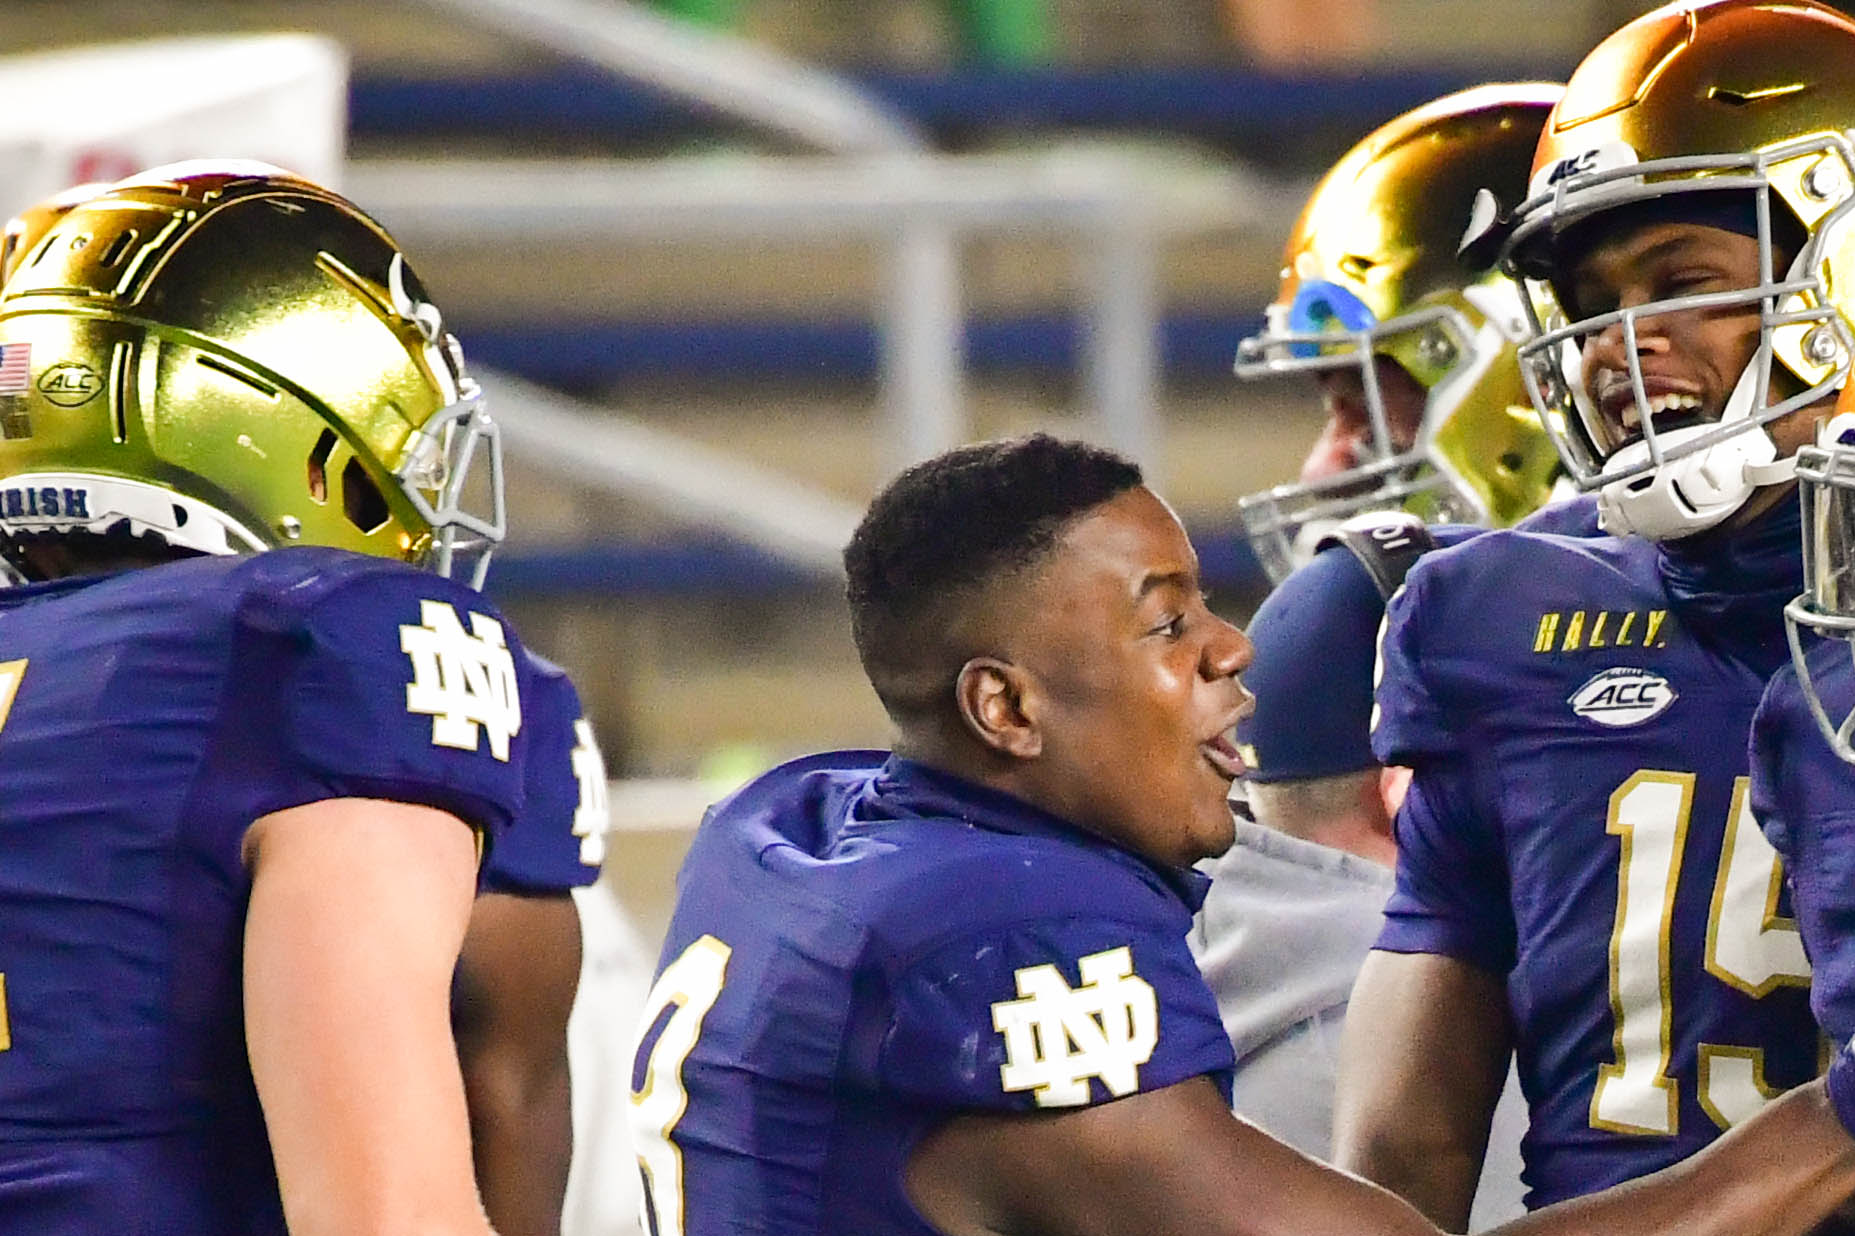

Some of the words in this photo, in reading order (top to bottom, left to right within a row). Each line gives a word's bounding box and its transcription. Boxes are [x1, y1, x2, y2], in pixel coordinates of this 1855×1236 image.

[46, 370, 94, 390] ACC
[1587, 683, 1662, 707] ACC
[1589, 769, 1812, 1136] 15
[990, 946, 1160, 1108] ND
